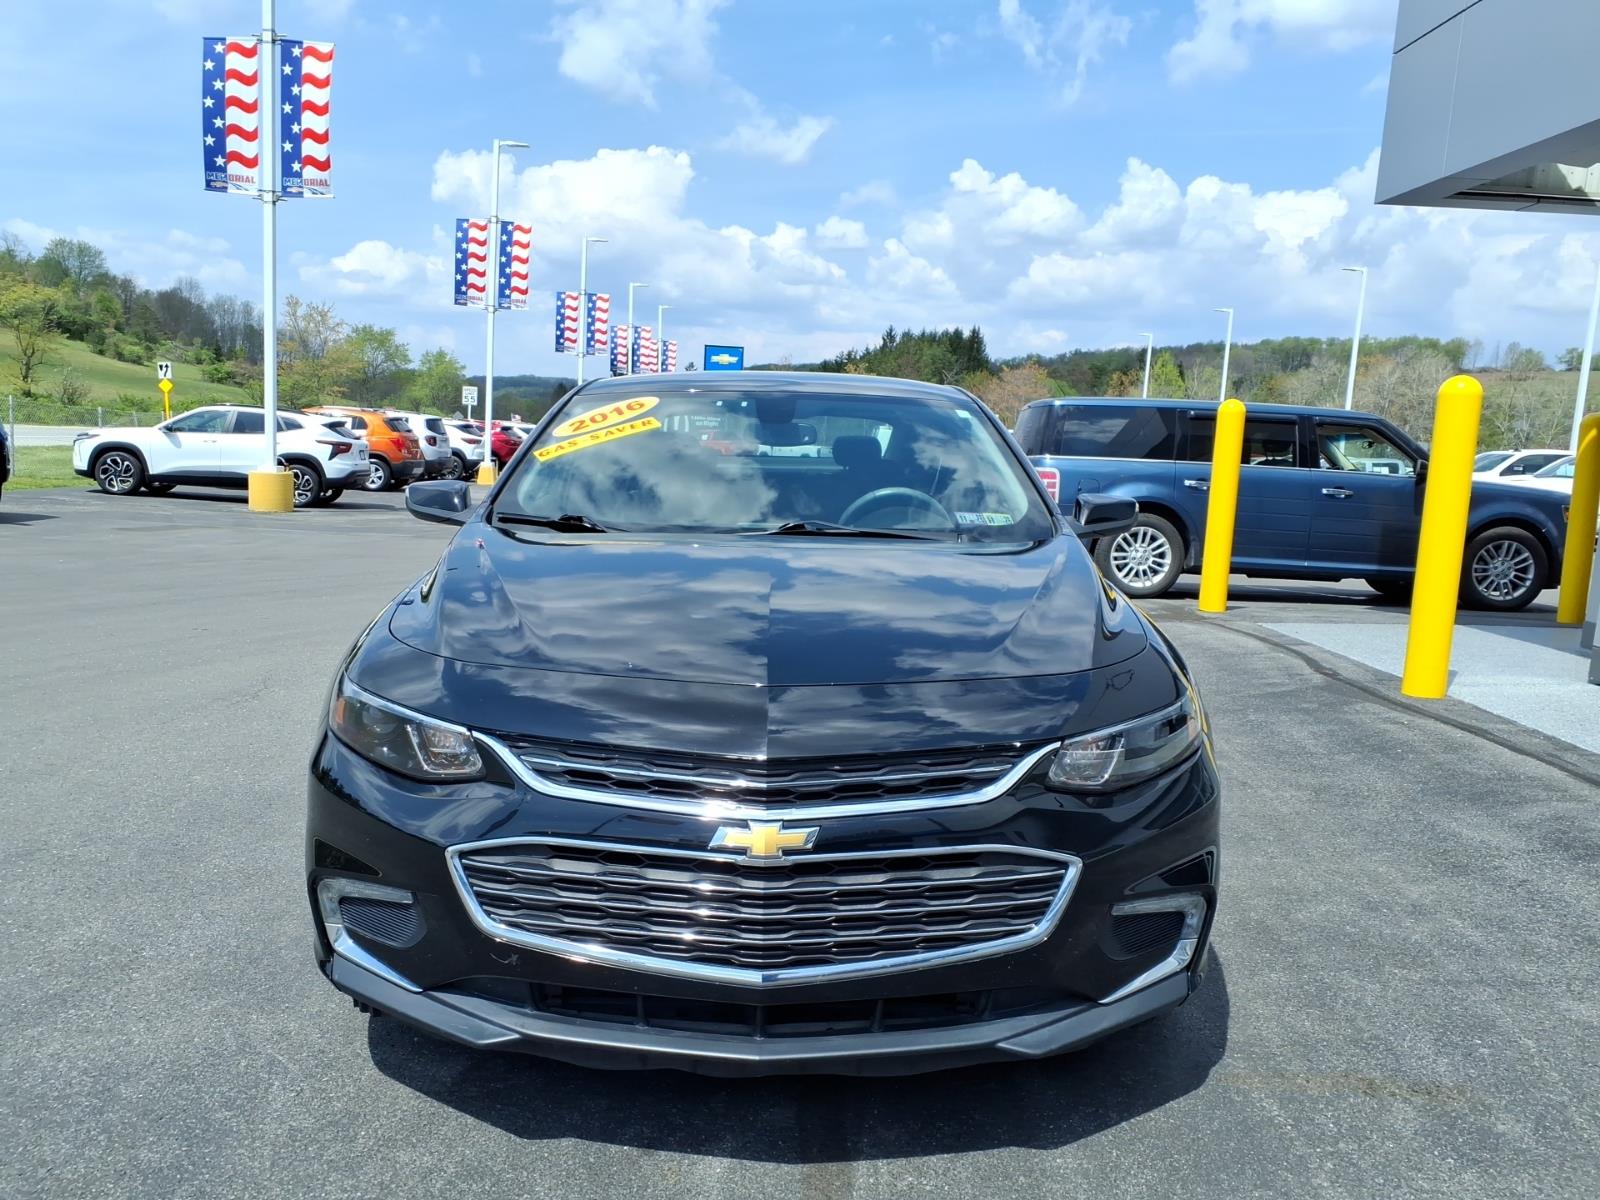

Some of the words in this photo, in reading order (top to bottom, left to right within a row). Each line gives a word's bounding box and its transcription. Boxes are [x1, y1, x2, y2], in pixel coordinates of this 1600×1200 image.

[206, 171, 256, 184] MEMORIAL
[283, 177, 330, 187] MEMORIAL
[464, 395, 476, 403] 55
[569, 401, 645, 432] 2016
[538, 441, 578, 457] GAS
[590, 419, 653, 440] SAVER
